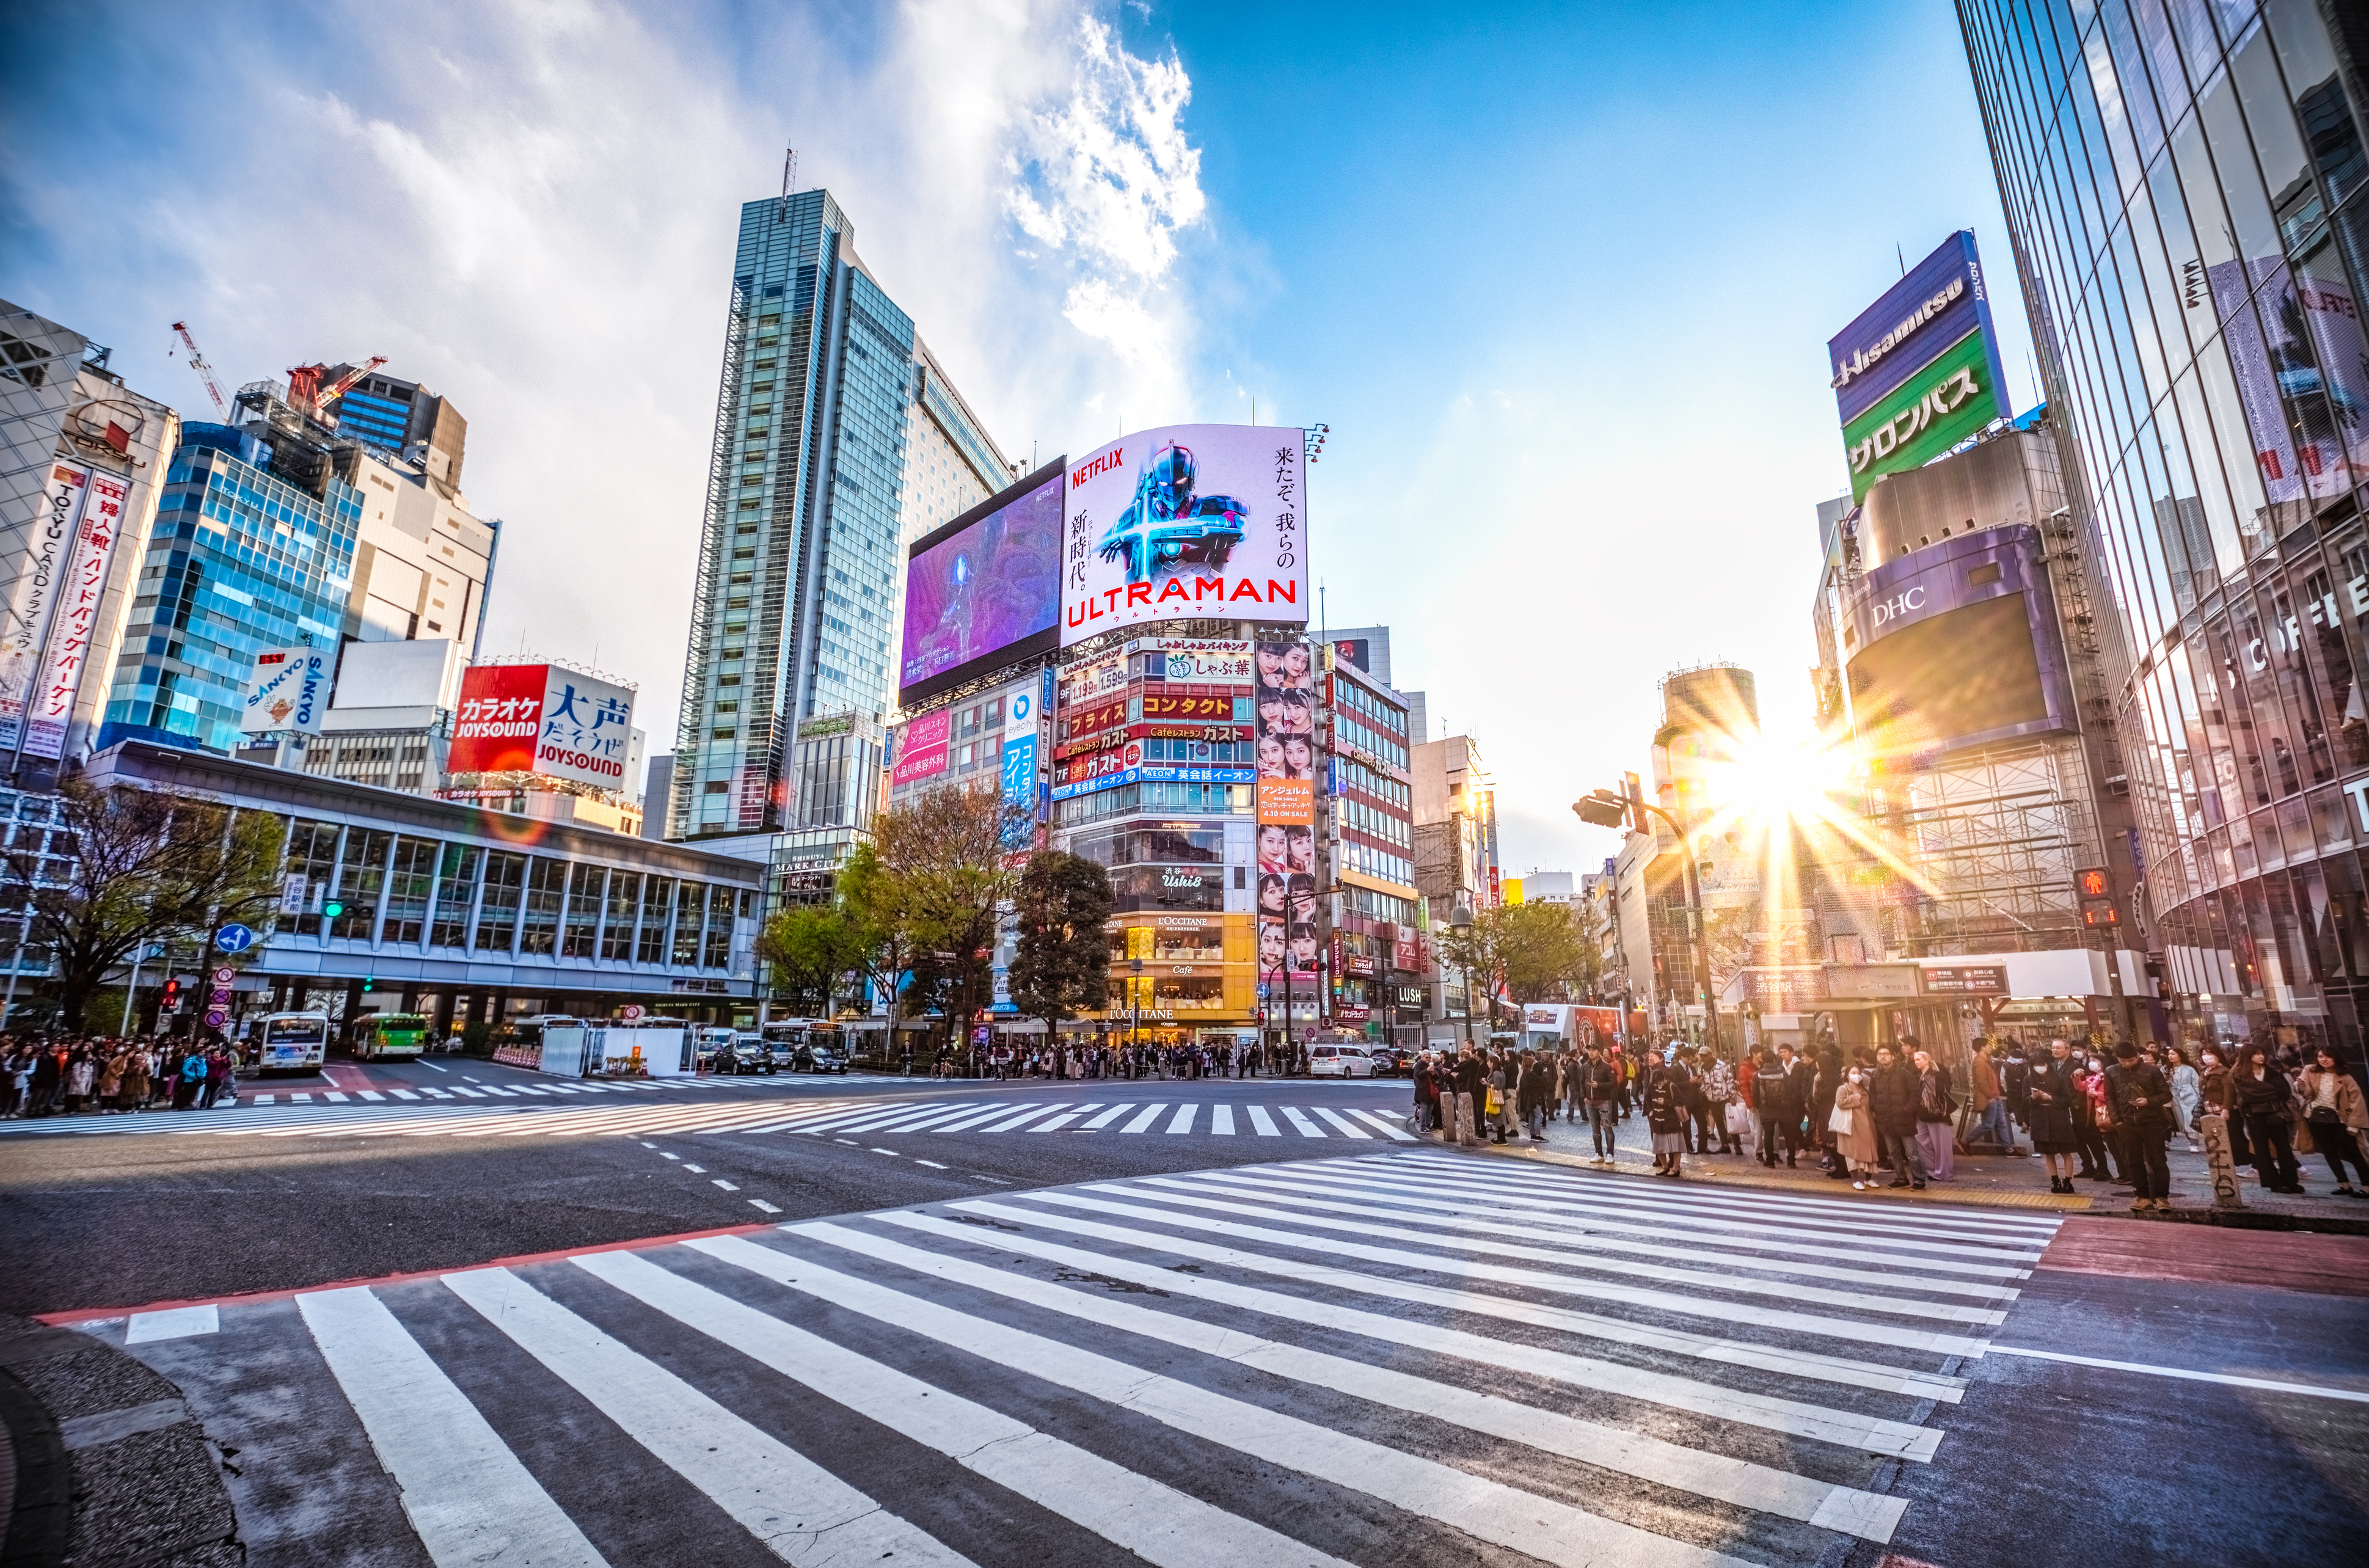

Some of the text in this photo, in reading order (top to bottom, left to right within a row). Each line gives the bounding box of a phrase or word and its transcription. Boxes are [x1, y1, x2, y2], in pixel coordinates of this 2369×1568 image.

[1969, 261, 1984, 301] サロンパス
[1831, 276, 1963, 389] Hisamitsu
[1847, 365, 1979, 475] サロンパス
[1073, 448, 1123, 490] NETFLIX
[222, 487, 258, 509] TOKYU
[1036, 486, 1054, 503] NETFLIX
[1275, 447, 1295, 569] 来たぞ、我らの
[1068, 509, 1087, 591] 新時代。
[48, 500, 119, 717] 婦人靴・ハンドバッグバーゲン
[1068, 577, 1296, 628] ULTRAMAN
[1872, 585, 1925, 628] DHC
[1114, 605, 1225, 622] ウルトラマン
[1129, 640, 1139, 651] 寿司
[1157, 639, 1249, 651] しゃぶしゃぶバイキング
[1064, 646, 1123, 676] しゃぶしゃぶバイキング
[1195, 659, 1250, 676] しゃぶ葉
[247, 658, 304, 707] SANKYO
[297, 655, 326, 724] SANKYO
[1060, 688, 1070, 700] 9F
[461, 697, 539, 721] カラオケ
[546, 684, 630, 730] 大声
[1144, 698, 1230, 715] コンタクト
[918, 717, 947, 734] 品川スキン
[1009, 720, 1033, 734] eyecity
[1071, 703, 1125, 734] プライス
[456, 721, 538, 738] JOYSOUND
[918, 728, 943, 745] クリニック
[1203, 726, 1243, 742] ガスト
[1100, 729, 1130, 749] ガスト
[538, 744, 622, 778] JOYSOUND
[900, 753, 944, 778] 品川美容外科
[1087, 754, 1120, 778] ガスト
[1126, 753, 1139, 762] ガスト
[1056, 769, 1068, 781] 7F
[1071, 764, 1086, 775] Café
[1145, 768, 1254, 781] AEON 英会話イーオン
[1053, 772, 1134, 797] AEON 英会話イーオン 6F
[1261, 786, 1310, 795] アンジュルム
[775, 862, 809, 872] MARK
[1162, 875, 1202, 888] Ushi8
[290, 877, 304, 911] 渋谷駅前
[1158, 917, 1207, 925] L'OCCITANE
[1401, 944, 1415, 957] アコム
[1173, 966, 1192, 976] Café
[1399, 987, 1421, 1003] LUSH
[1756, 982, 1792, 993] 渋谷駅
